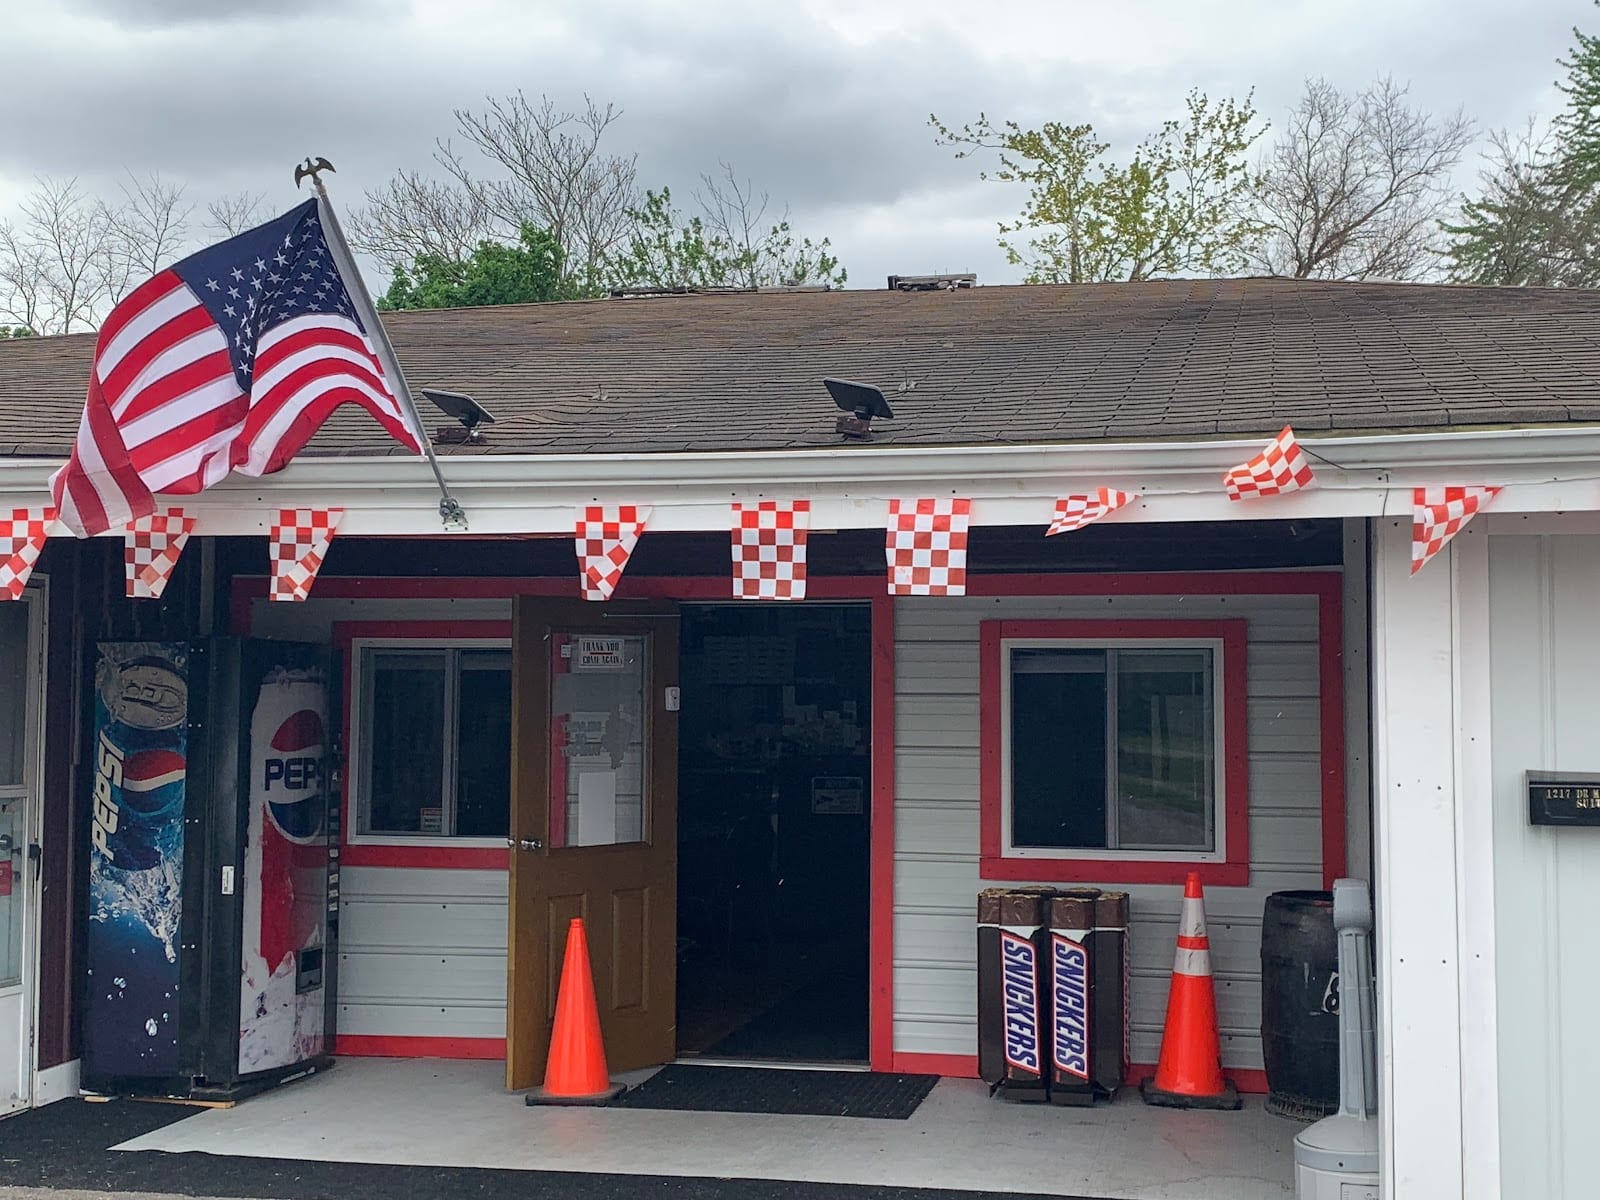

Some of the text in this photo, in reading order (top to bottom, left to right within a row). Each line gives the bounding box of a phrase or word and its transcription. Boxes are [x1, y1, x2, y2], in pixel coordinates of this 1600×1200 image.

[91, 729, 125, 861] PEPSI
[1546, 788, 1571, 799] 1217
[1576, 788, 1589, 799] DR
[1003, 939, 1037, 1068] SNICKERS
[1055, 942, 1085, 1073] SNICKERS
